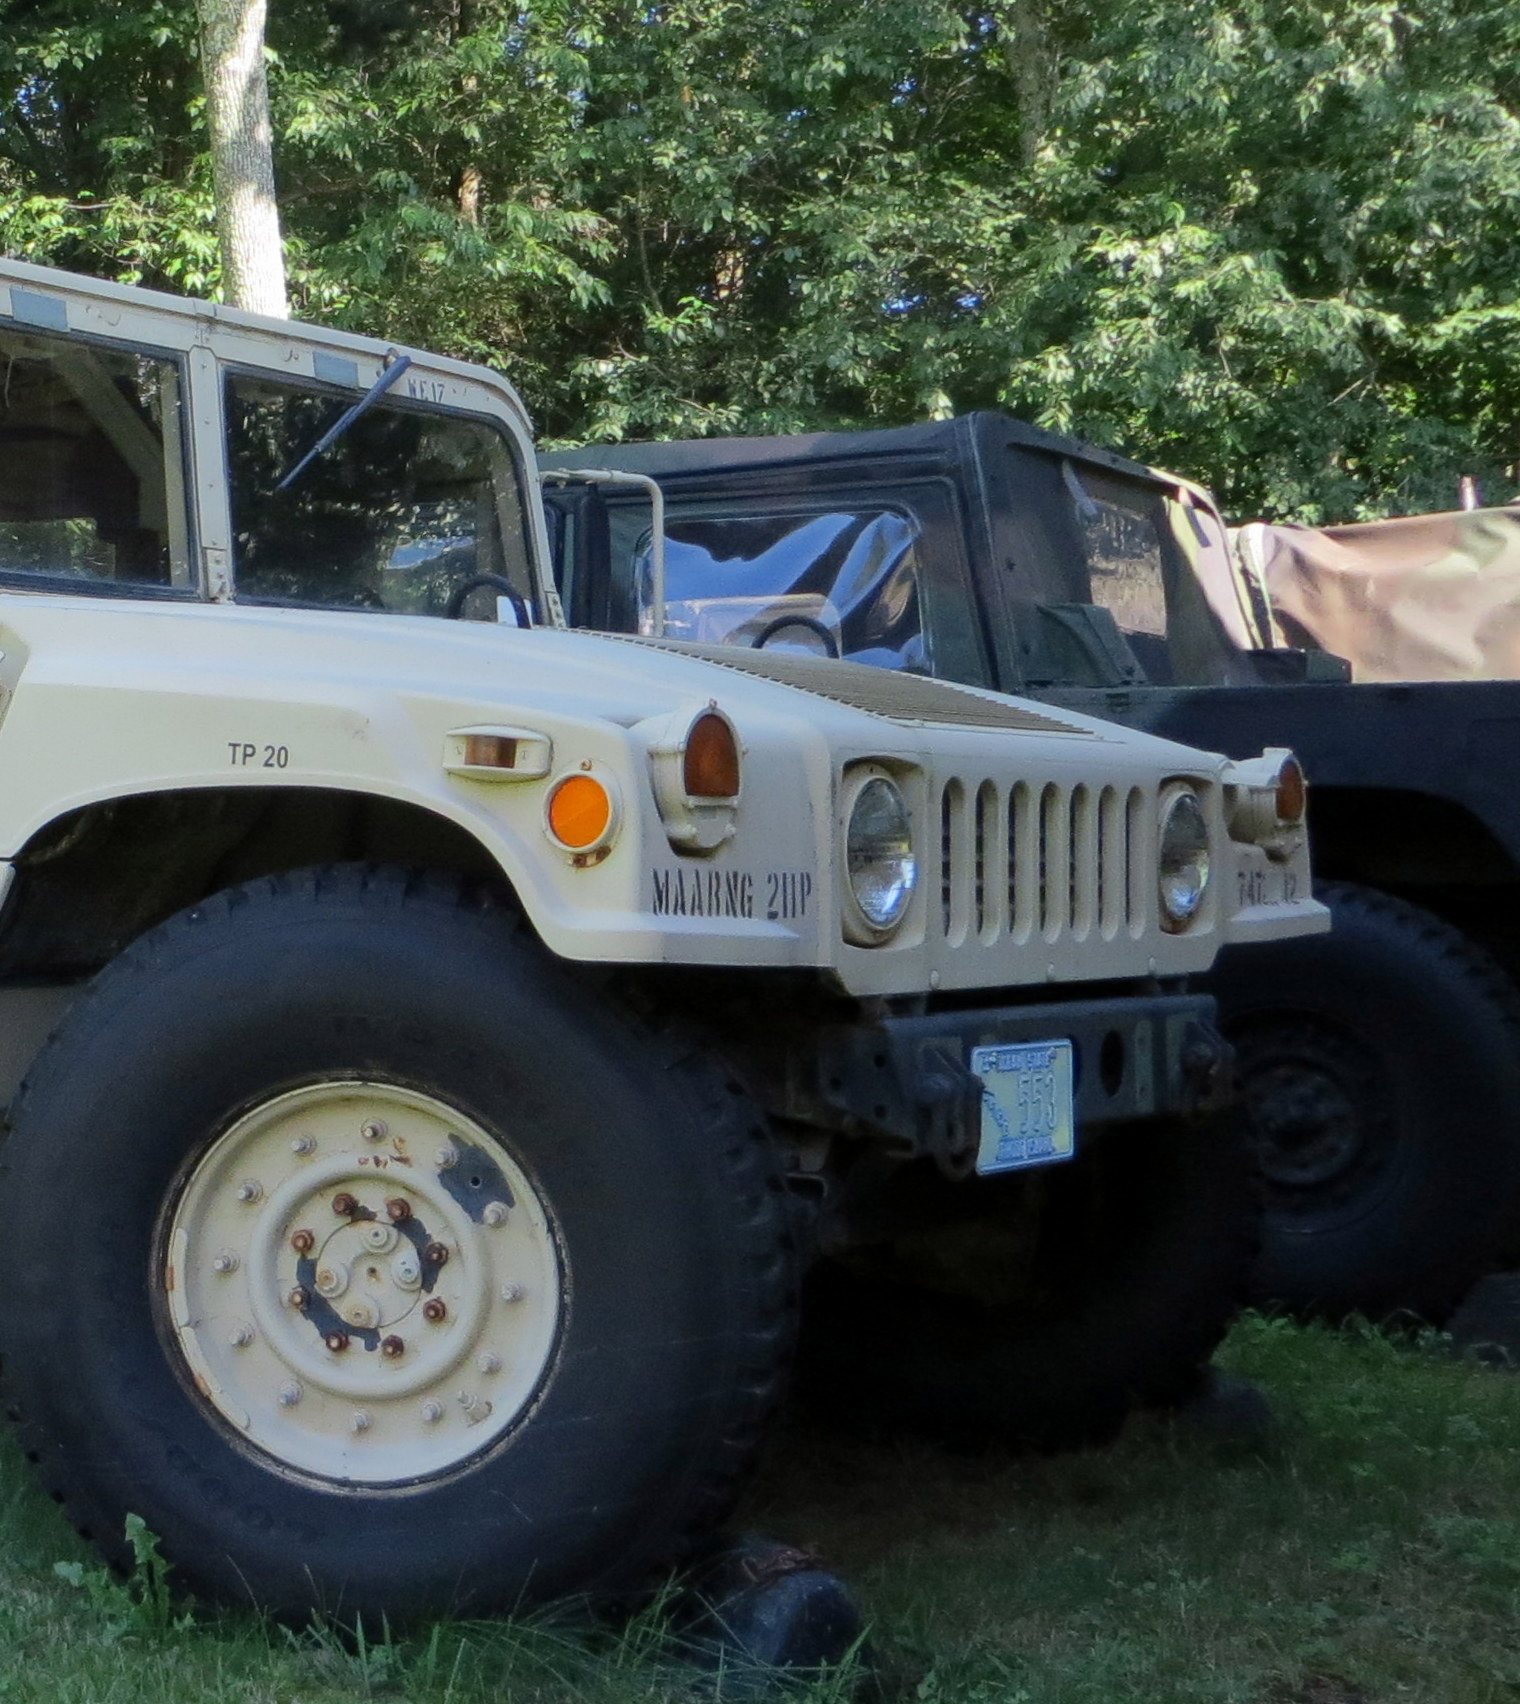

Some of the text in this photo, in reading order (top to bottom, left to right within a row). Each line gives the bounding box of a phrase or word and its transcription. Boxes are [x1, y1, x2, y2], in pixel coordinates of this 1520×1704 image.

[228, 742, 289, 768] TP 20
[652, 868, 753, 919] MAARNG
